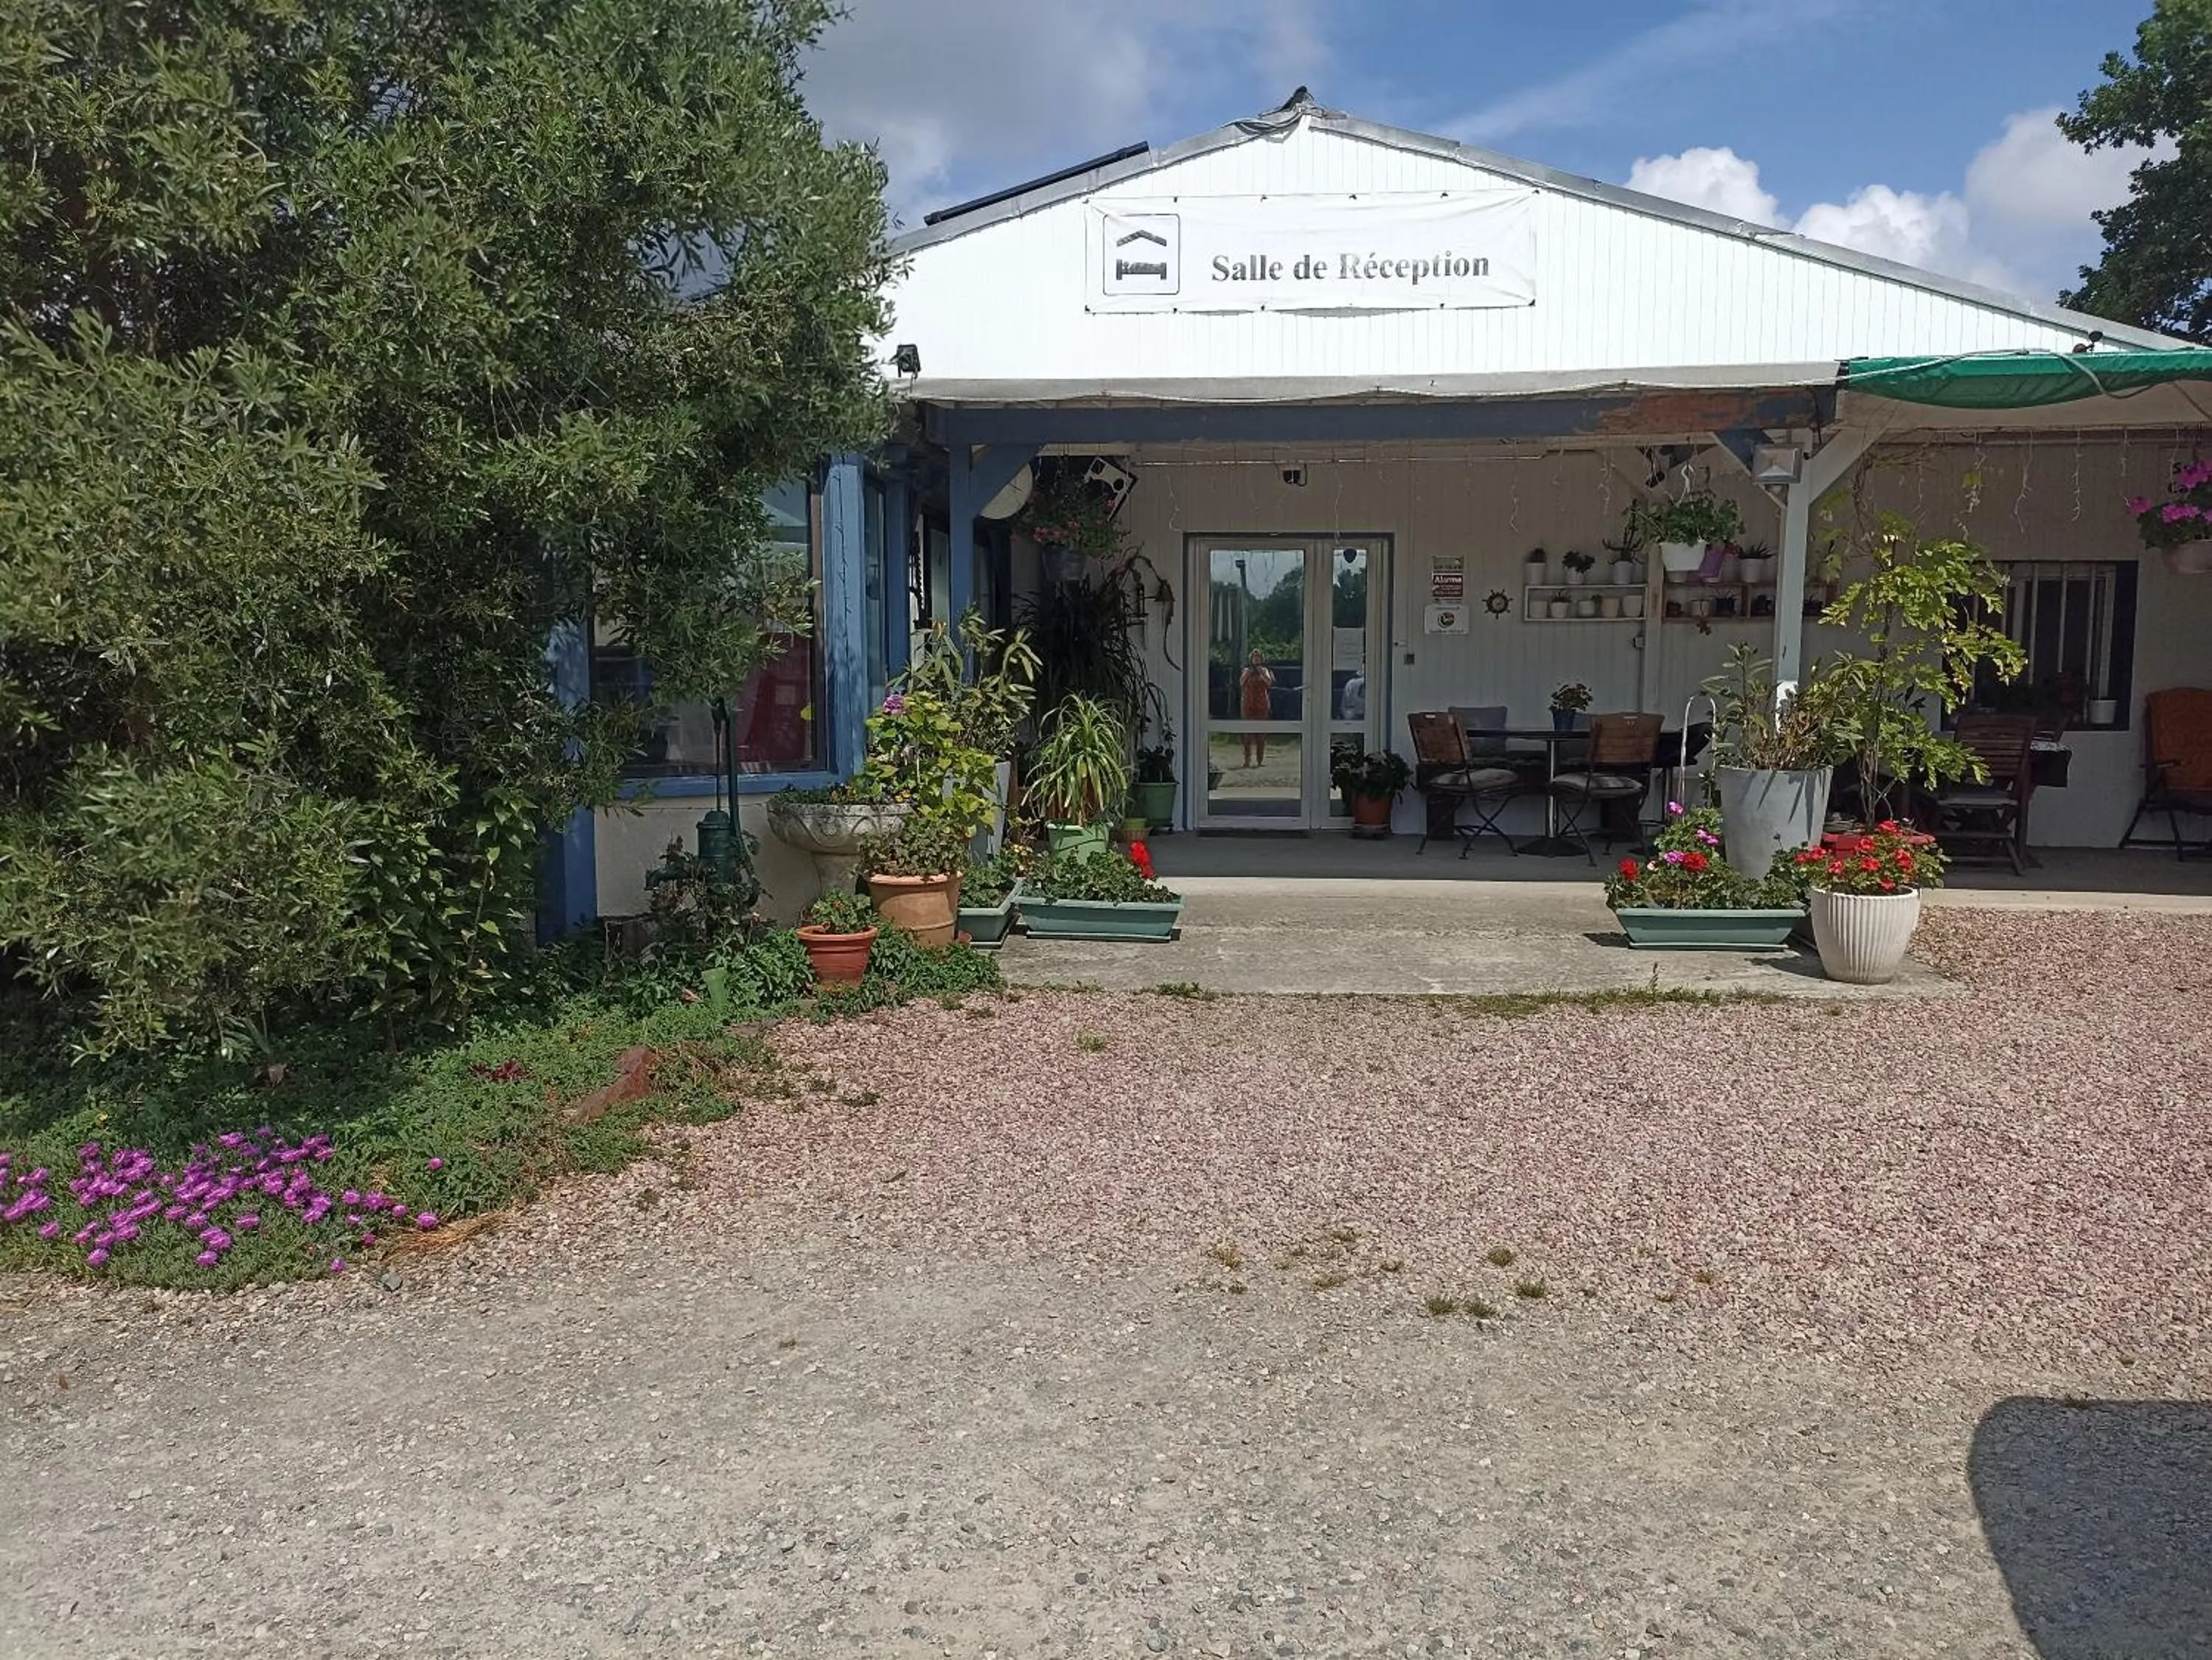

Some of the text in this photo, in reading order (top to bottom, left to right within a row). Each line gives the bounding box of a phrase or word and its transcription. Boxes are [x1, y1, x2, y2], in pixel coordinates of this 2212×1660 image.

[1211, 251, 1489, 285] Salle de Réception
